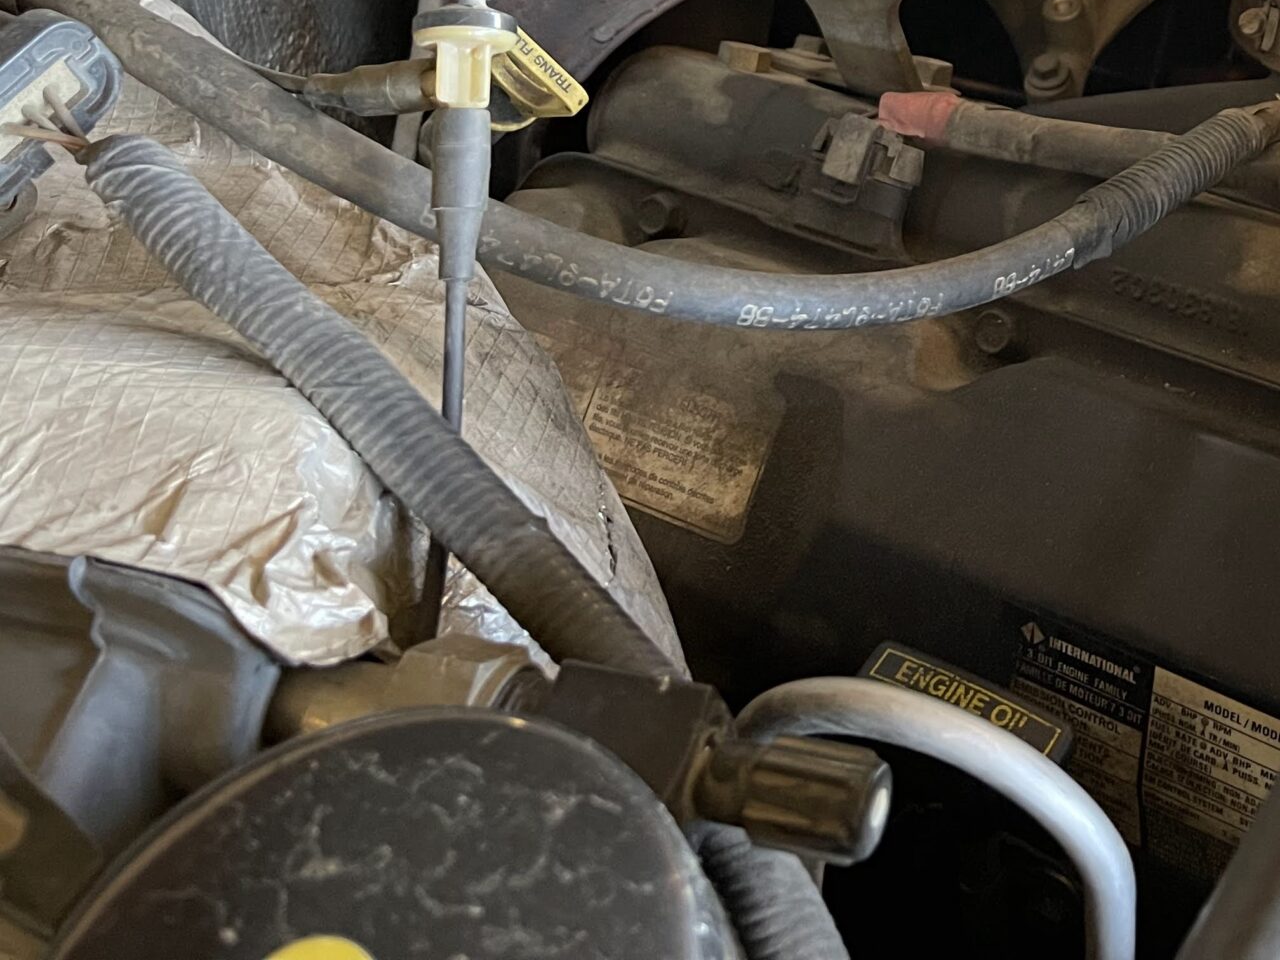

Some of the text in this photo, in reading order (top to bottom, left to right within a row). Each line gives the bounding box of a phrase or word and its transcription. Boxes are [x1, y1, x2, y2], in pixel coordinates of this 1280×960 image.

[534, 55, 573, 94] TRANS
[1048, 635, 1136, 685] INTERNATIONAL
[895, 660, 990, 716] ENGINE
[1055, 677, 1066, 691] DE
[1069, 683, 1107, 710] MOTEUR
[1057, 661, 1089, 684] ENGINE
[1093, 677, 1127, 701] FAMILY
[1067, 703, 1120, 735] CONTROL
[1203, 699, 1241, 725] MODEL
[1212, 721, 1231, 736] RPM
[1150, 720, 1170, 734] FUEL
[1175, 731, 1196, 746] RATE
